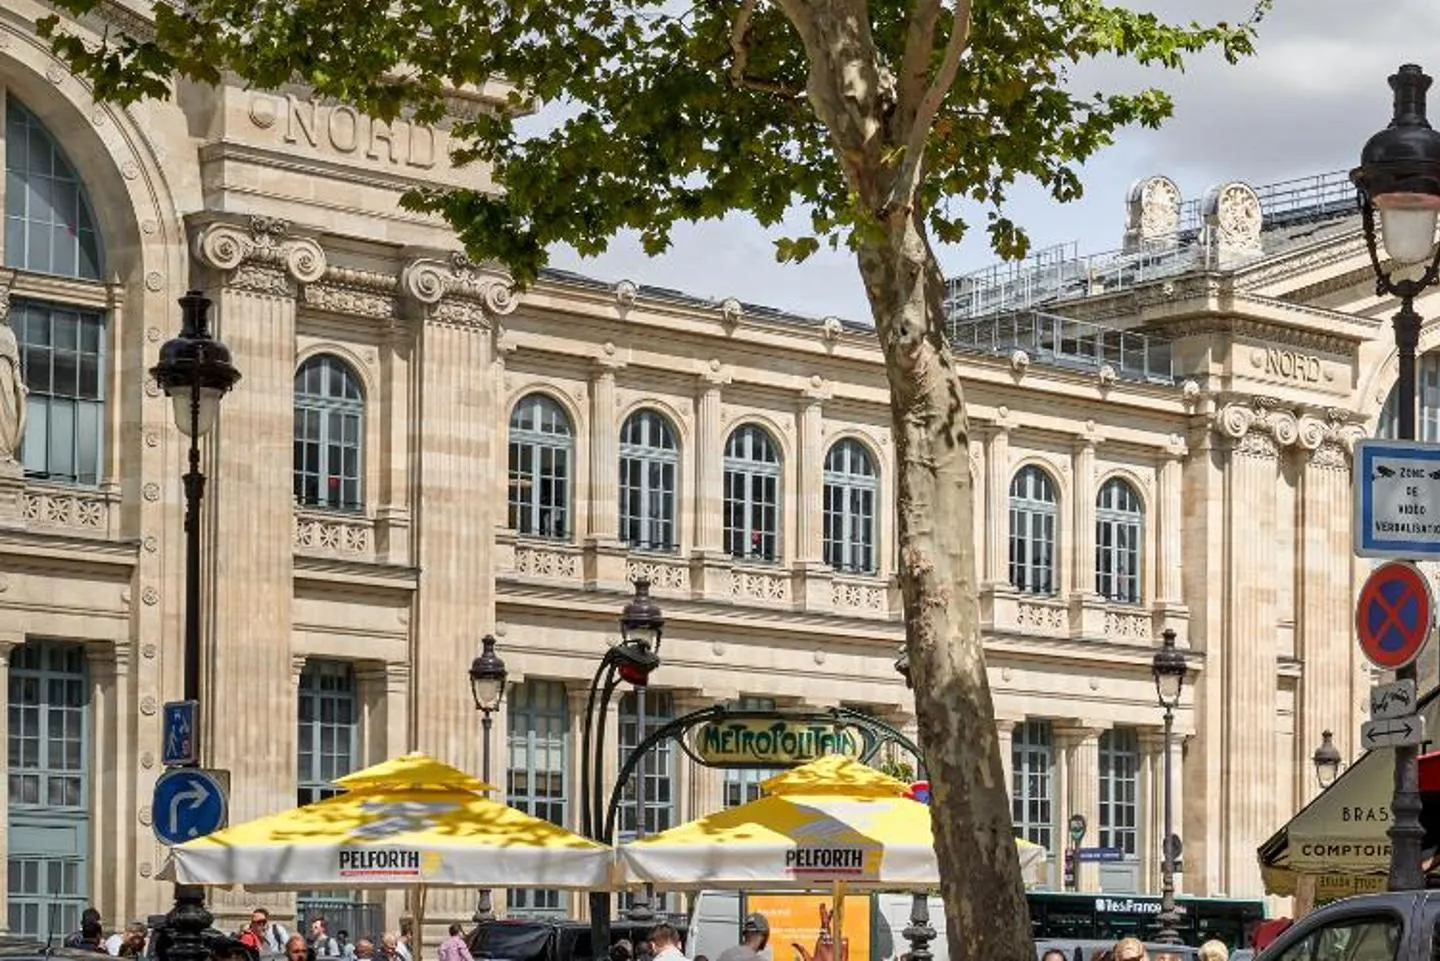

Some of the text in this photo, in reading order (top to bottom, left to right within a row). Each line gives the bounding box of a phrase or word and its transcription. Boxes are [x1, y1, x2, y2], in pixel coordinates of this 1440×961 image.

[282, 93, 437, 171] NORD
[1264, 346, 1321, 383] NORD
[1400, 467, 1425, 478] ZONE
[1406, 486, 1418, 497] DE
[1343, 807, 1394, 822] BRAS
[340, 850, 419, 869] PELFORTH
[786, 849, 862, 867] PELFORTH
